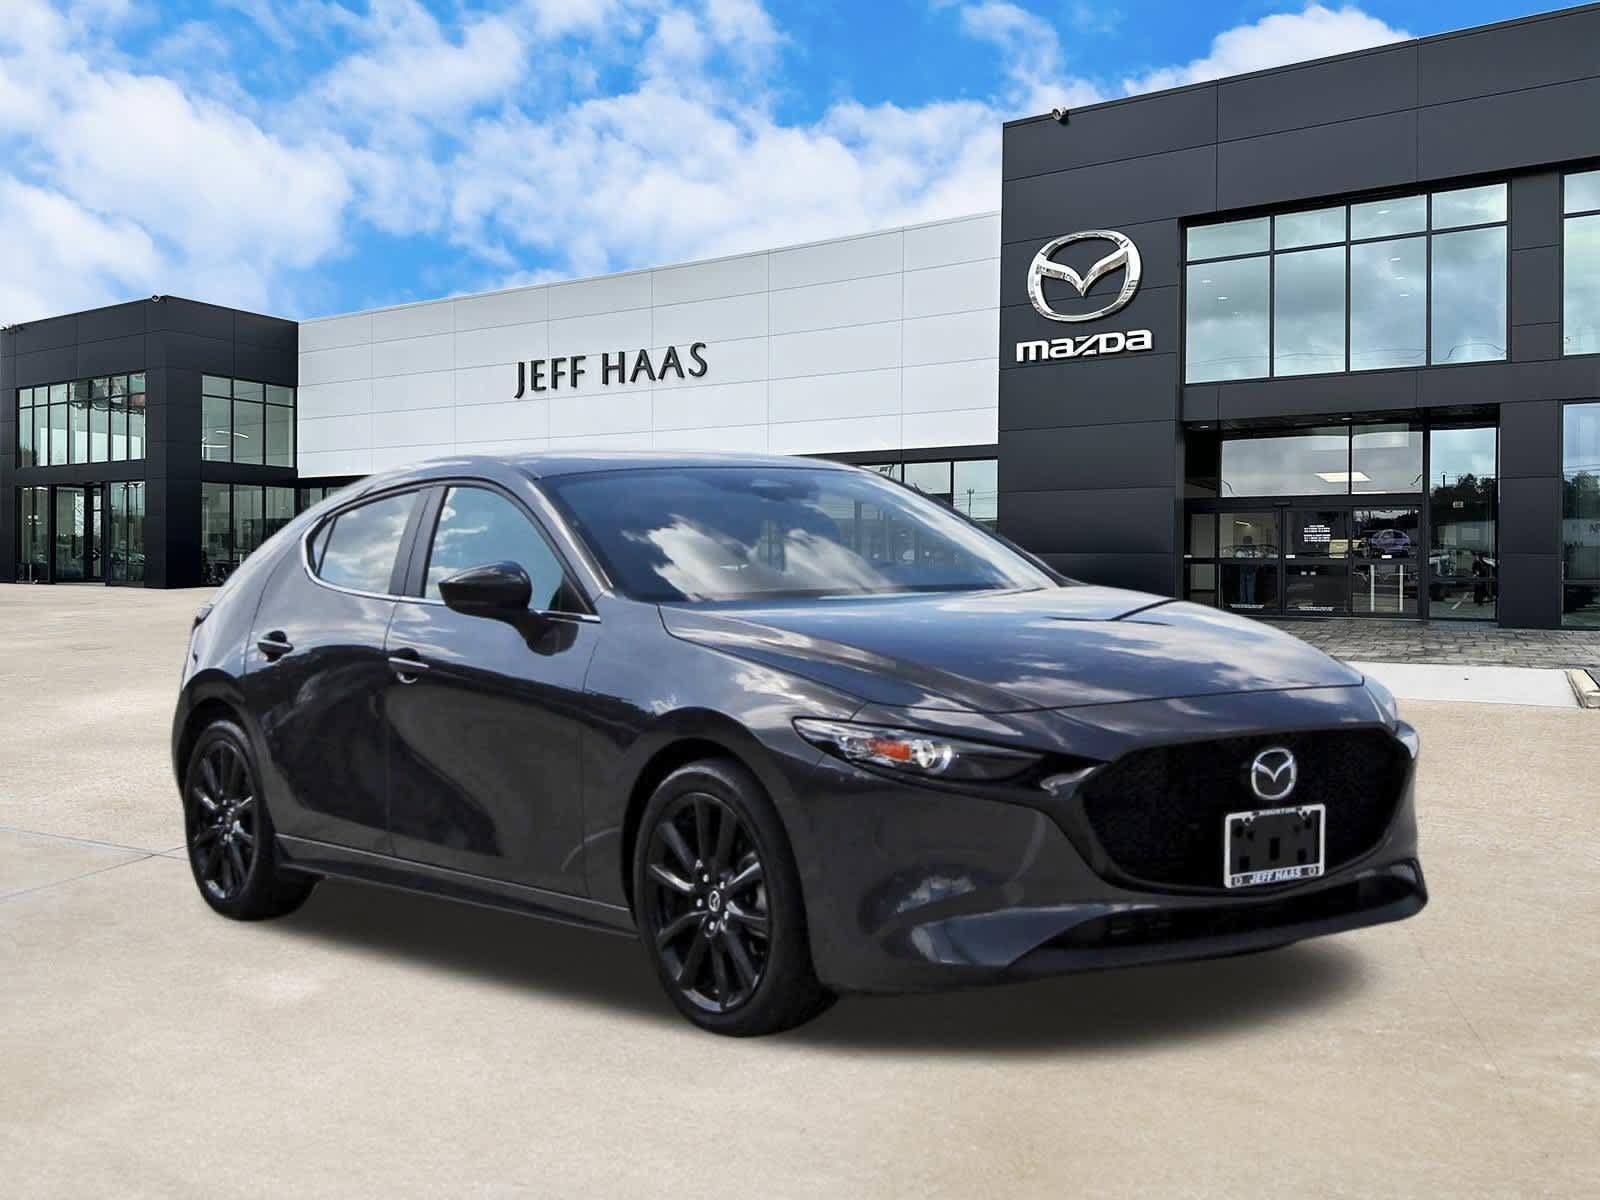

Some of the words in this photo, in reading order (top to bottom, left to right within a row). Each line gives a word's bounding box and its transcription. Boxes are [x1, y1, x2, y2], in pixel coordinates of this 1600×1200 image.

[513, 355, 587, 399] JEFF
[601, 342, 708, 386] HAAS
[1250, 870, 1274, 884] JEFF
[1275, 866, 1301, 881] HAAS
